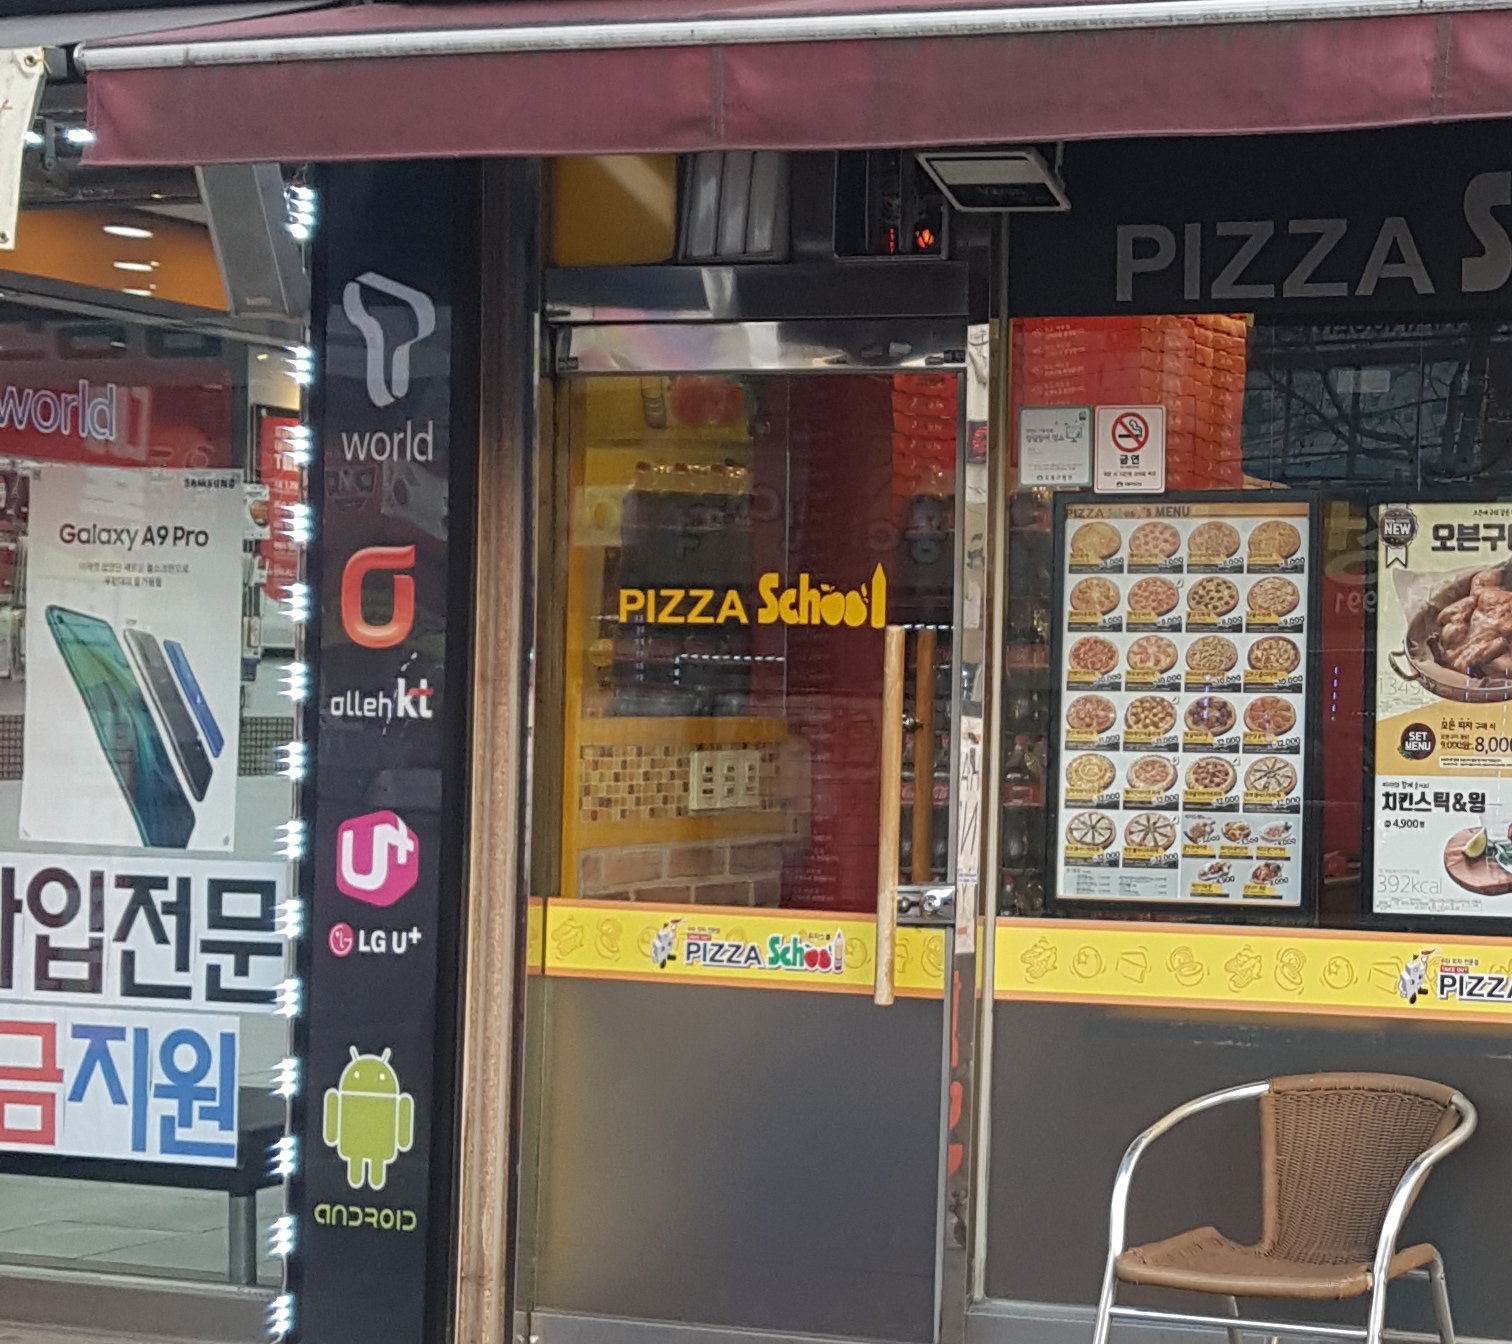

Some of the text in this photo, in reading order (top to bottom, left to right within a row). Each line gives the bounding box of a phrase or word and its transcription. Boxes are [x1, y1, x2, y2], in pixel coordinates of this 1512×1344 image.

[1116, 215, 1436, 302] PIZZA
[342, 419, 433, 462] world
[184, 478, 236, 489] SAMSUNG
[1154, 506, 1191, 518] MENU
[59, 524, 209, 552] Galaxy A9 Pro
[1384, 523, 1411, 535] NEW
[619, 562, 887, 629] PIZZA School
[331, 678, 434, 719] olleh kt
[1404, 741, 1431, 752] MENU
[1408, 731, 1428, 742] SET
[1382, 791, 1487, 814] 치킨스틱&윙
[358, 928, 387, 954] LG
[685, 927, 845, 974] PIZZA School
